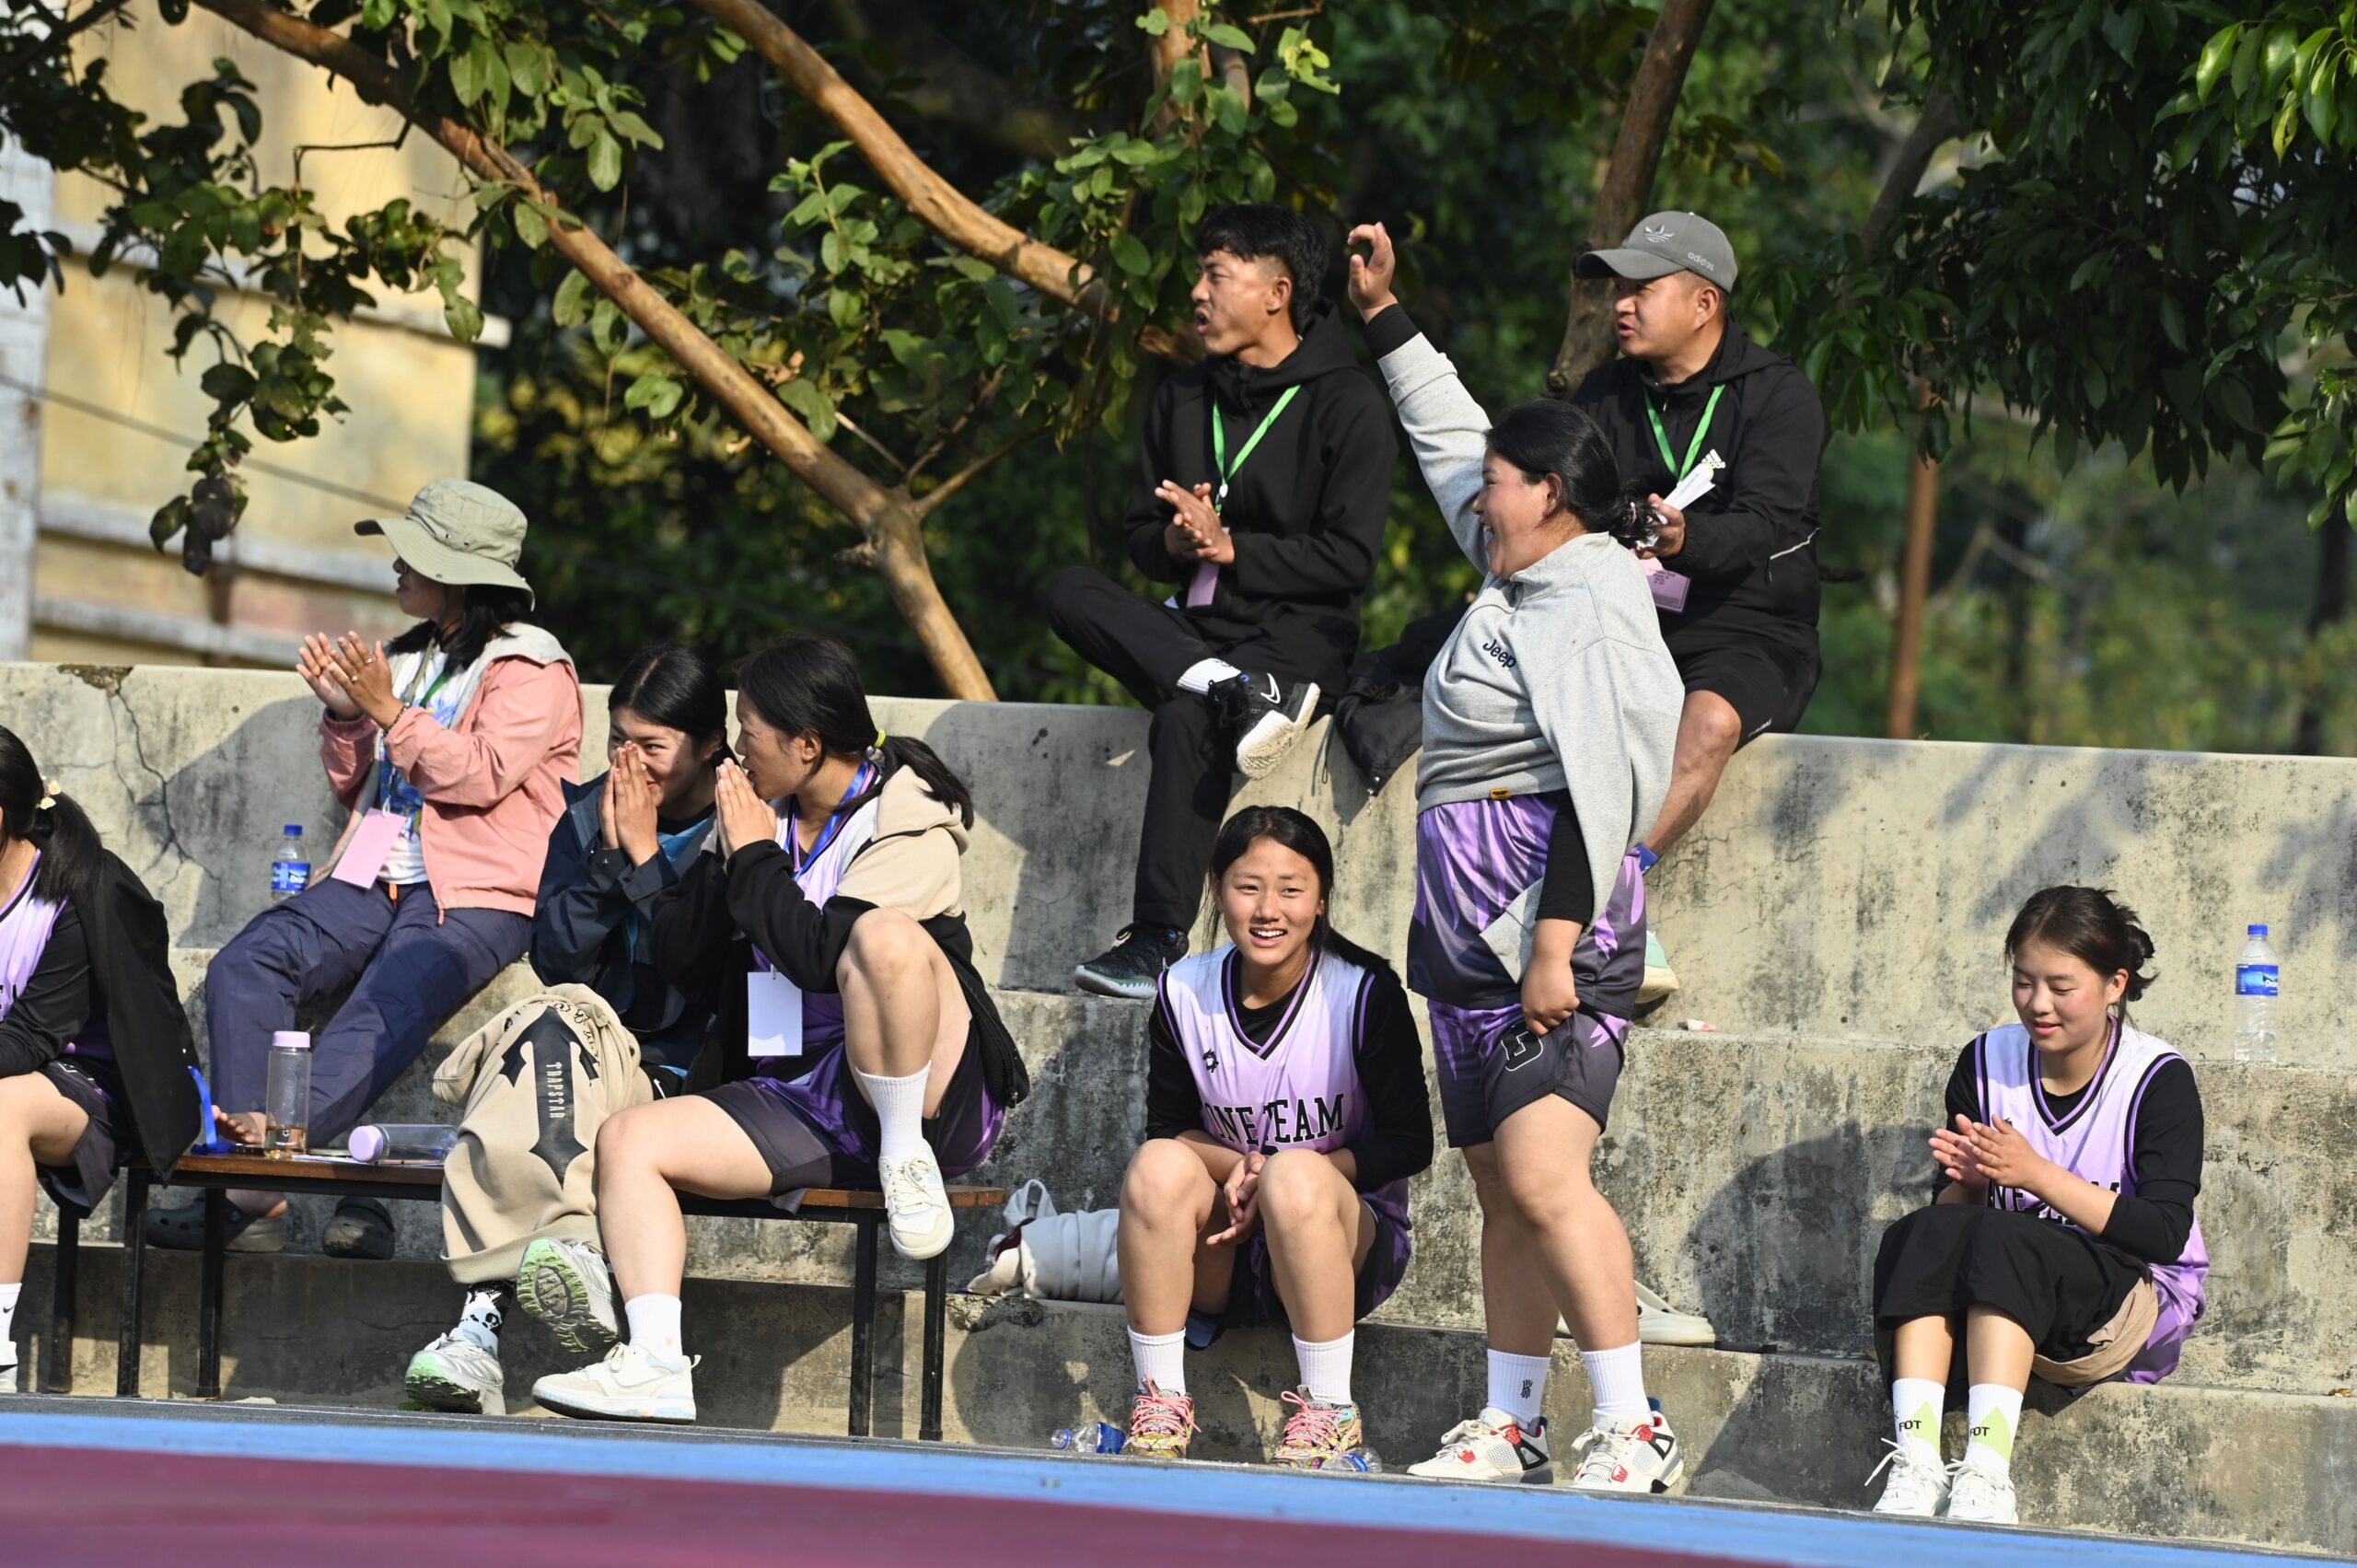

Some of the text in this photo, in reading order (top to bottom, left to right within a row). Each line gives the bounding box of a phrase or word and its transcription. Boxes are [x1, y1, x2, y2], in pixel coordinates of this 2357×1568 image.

[1688, 251, 1715, 272] adidas
[1482, 639, 1517, 668] Jeep
[544, 1062, 566, 1119] TRAPSTAR
[1262, 1093, 1345, 1144] TEAM
